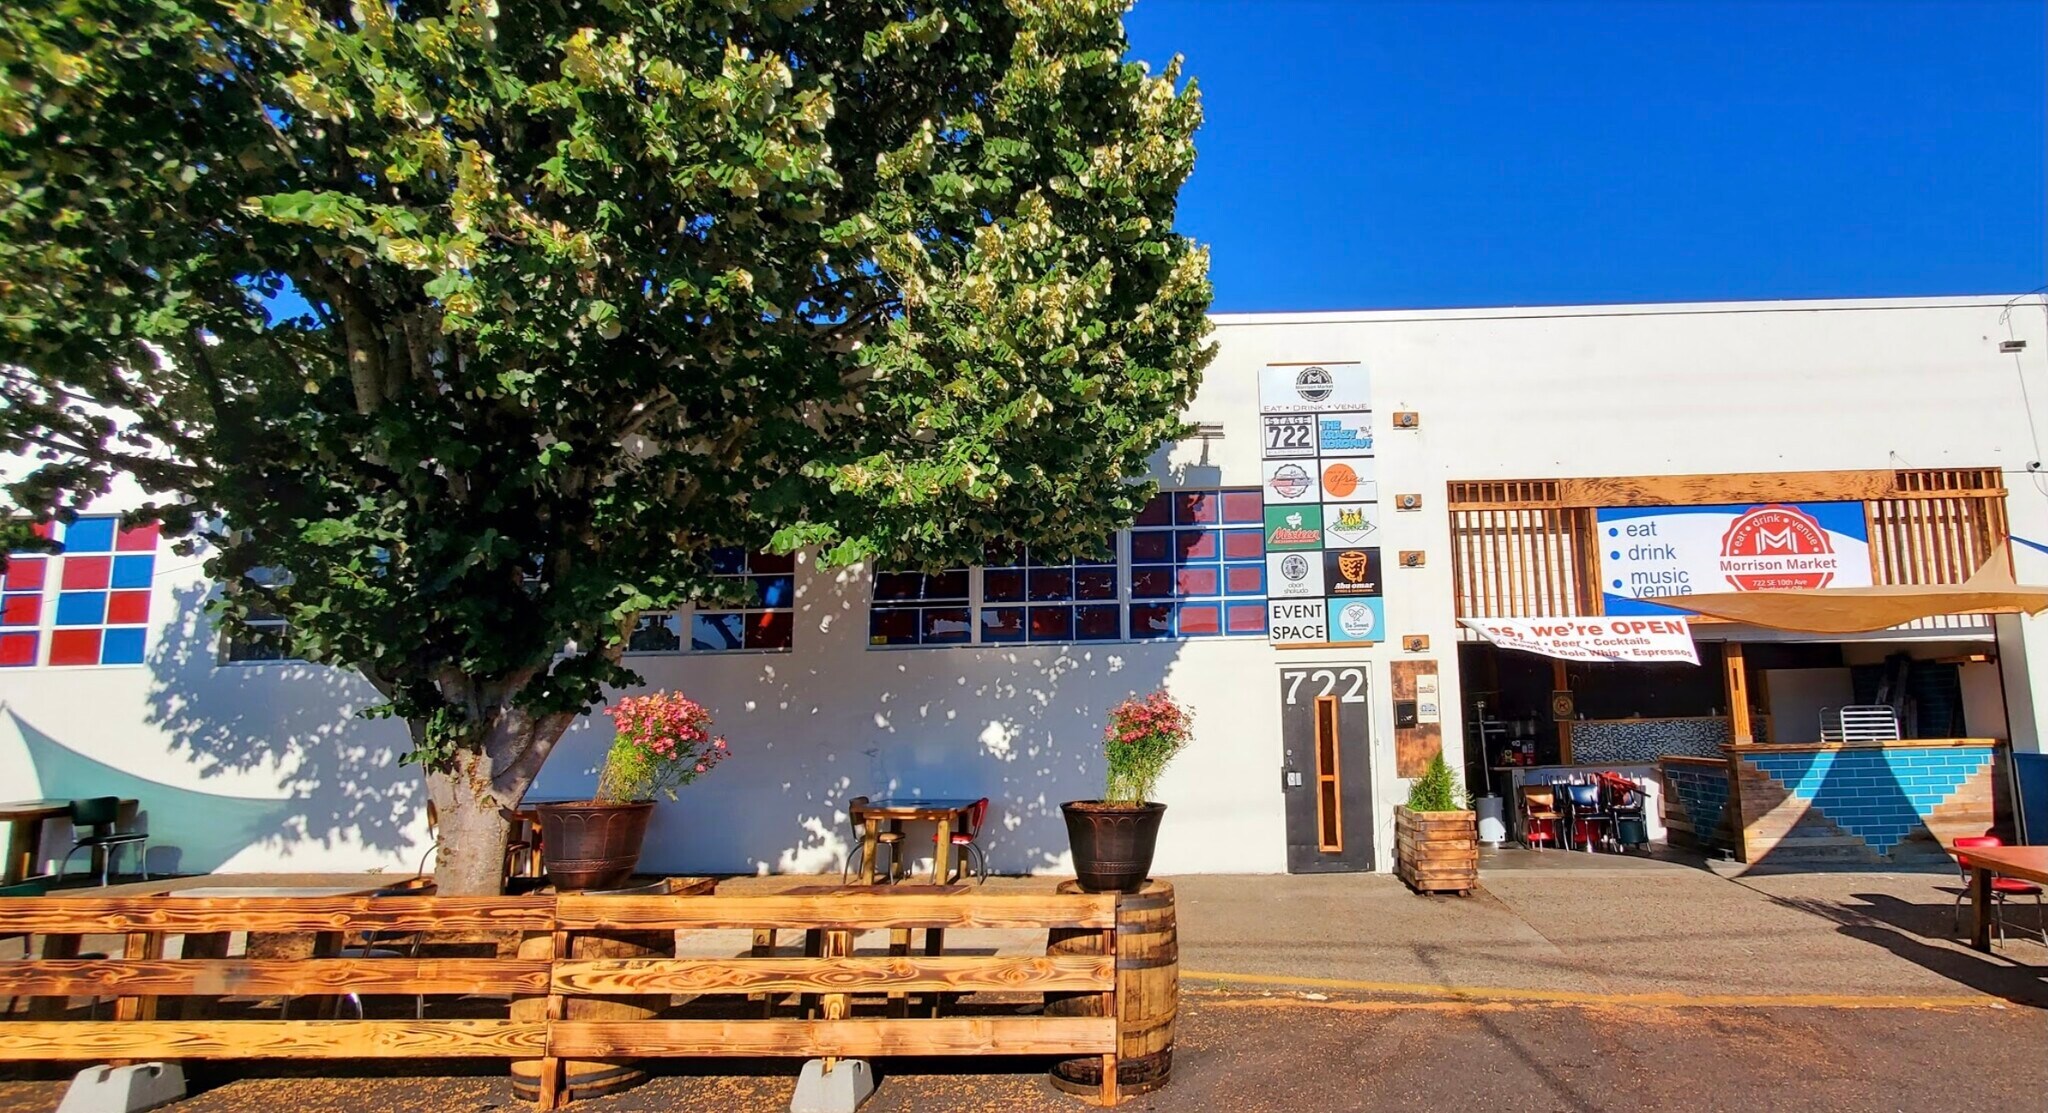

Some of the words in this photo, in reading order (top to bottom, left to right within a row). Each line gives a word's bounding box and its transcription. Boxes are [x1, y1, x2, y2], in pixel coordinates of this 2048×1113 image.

[1265, 417, 1312, 425] STAGE
[1320, 420, 1342, 431] THE
[1268, 425, 1310, 448] 722
[1752, 513, 1781, 528] drink
[1626, 521, 1658, 537] eat
[1791, 519, 1819, 546] venue
[1734, 530, 1748, 548] eat
[1628, 543, 1677, 561] drink
[1720, 560, 1783, 572] Morrison
[1786, 558, 1838, 571] Market
[1631, 567, 1690, 585] music
[1752, 579, 1767, 587] 722
[1767, 579, 1777, 587] SE
[1777, 578, 1794, 586] 10th
[1632, 584, 1693, 599] venue
[1273, 604, 1323, 619] EVENT
[1272, 626, 1325, 640] SPACE
[1611, 621, 1685, 636] OPEN
[1552, 639, 1581, 649] Beer
[1593, 637, 1651, 647] Cocktails
[1559, 649, 1586, 658] Dole
[1590, 649, 1620, 658] Whip
[1632, 647, 1693, 659] Espressos
[1284, 668, 1365, 705] 722
